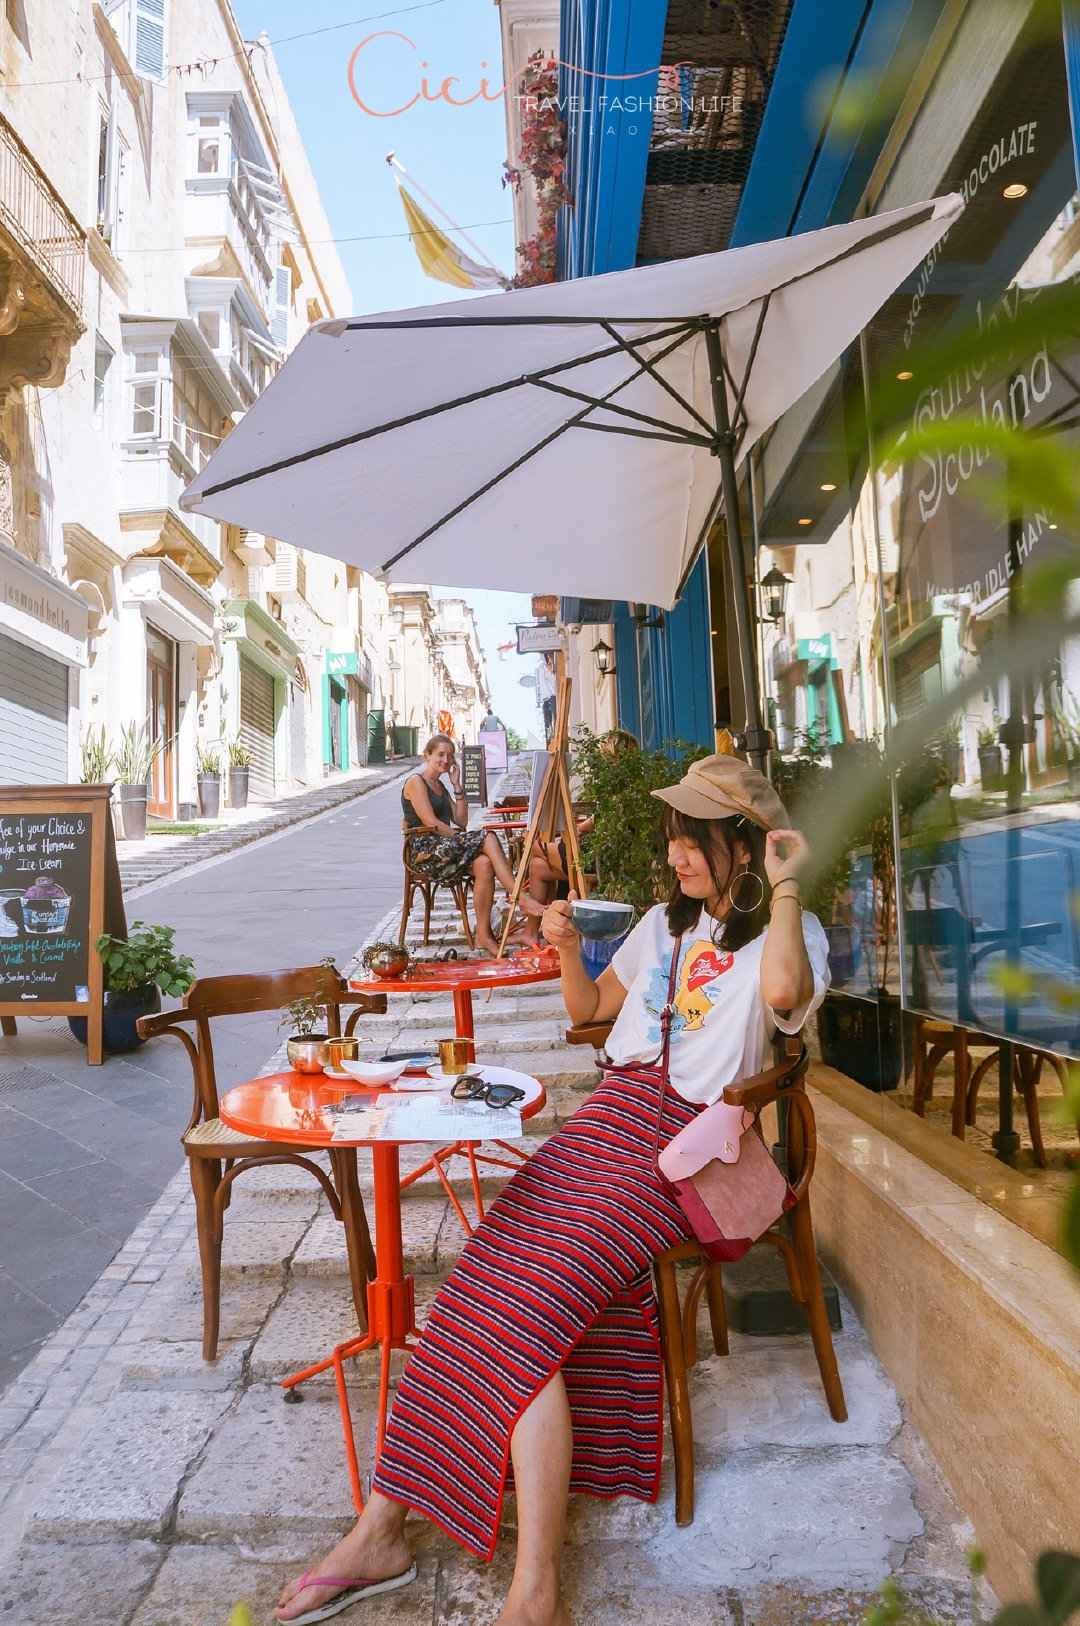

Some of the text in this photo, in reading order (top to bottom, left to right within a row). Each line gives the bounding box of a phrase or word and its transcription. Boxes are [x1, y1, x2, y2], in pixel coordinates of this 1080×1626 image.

[959, 121, 1037, 204] HOCOLATE
[985, 551, 1015, 598] IDLE
[27, 823, 47, 841] your
[48, 817, 75, 836] Choice
